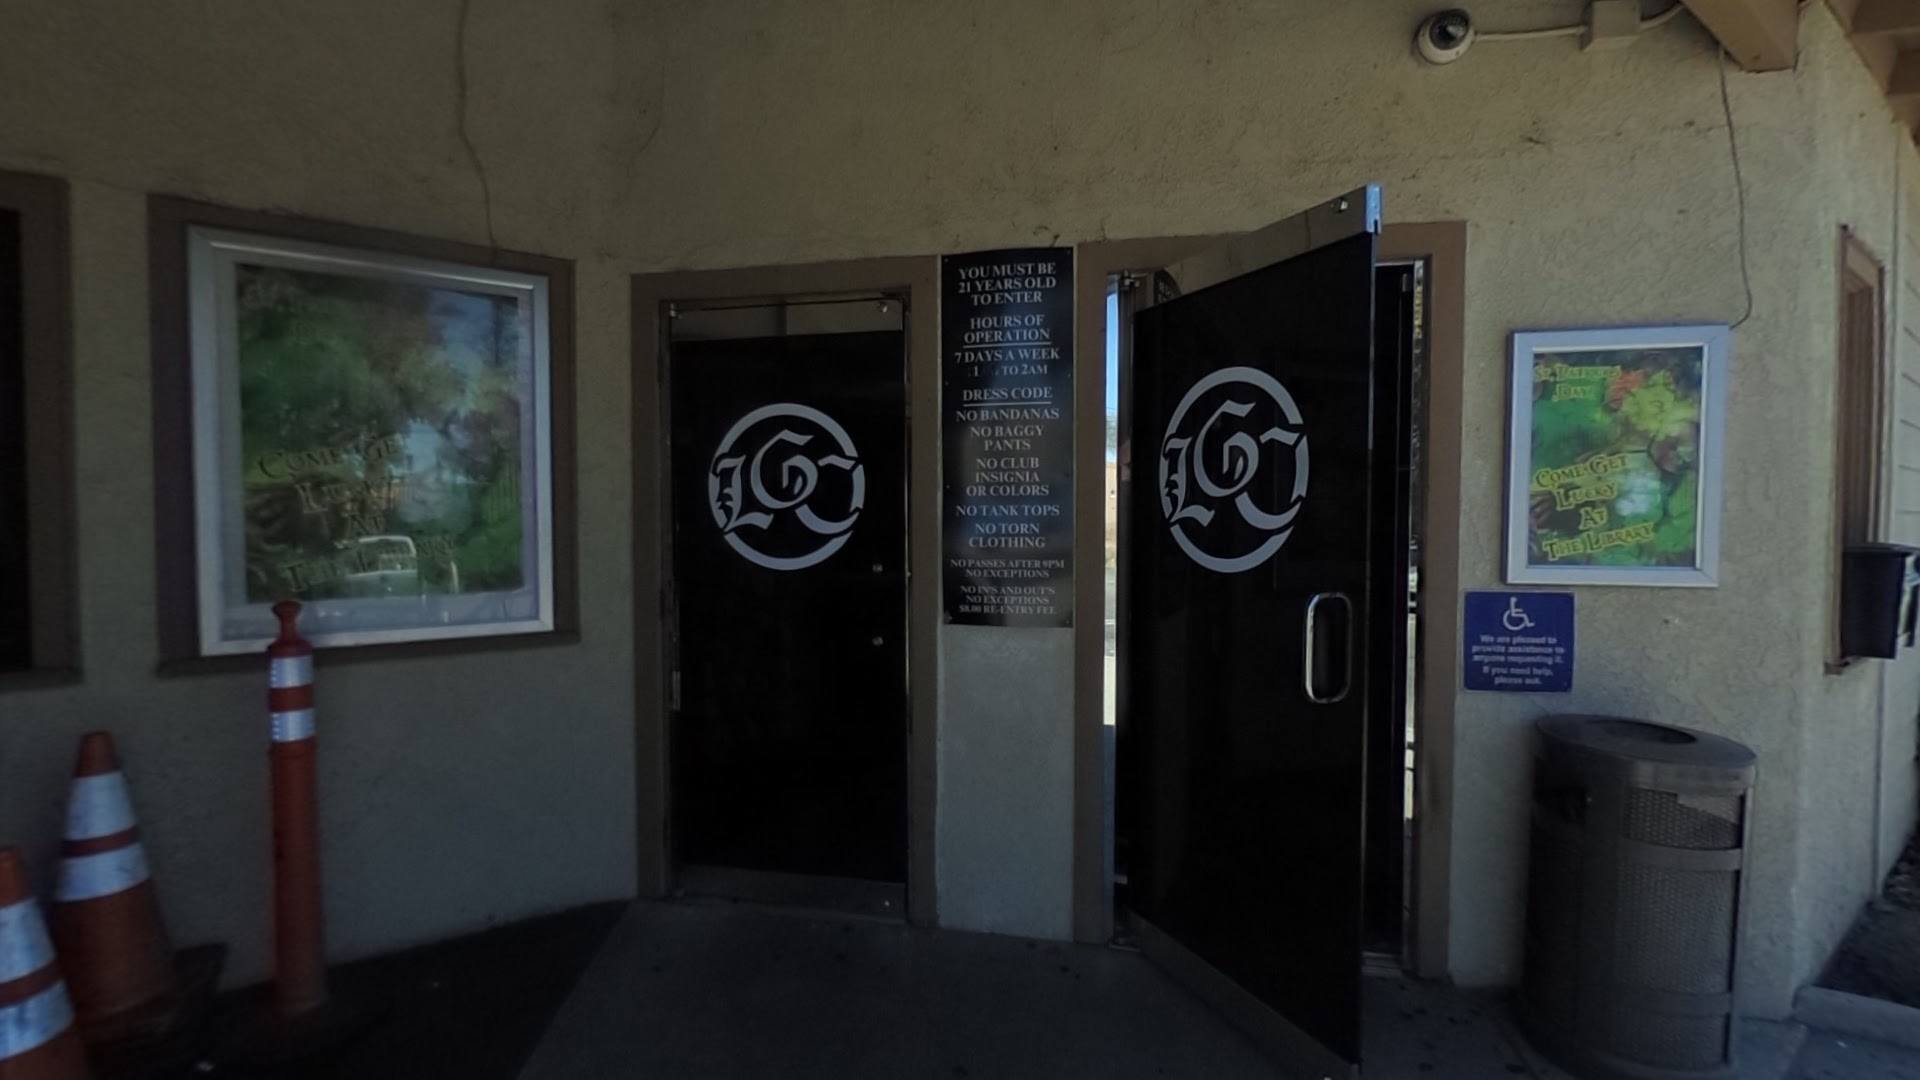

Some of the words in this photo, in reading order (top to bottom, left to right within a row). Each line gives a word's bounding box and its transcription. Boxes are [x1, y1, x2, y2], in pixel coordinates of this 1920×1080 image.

[958, 266, 990, 280] YOU
[992, 263, 1034, 277] MUST
[1037, 262, 1057, 275] BE
[958, 282, 971, 294] 21
[975, 279, 1022, 292] YEARS
[1024, 276, 1057, 289] OLD
[971, 293, 992, 306] TO
[994, 290, 1043, 305] ENTER
[970, 315, 1022, 329] HOURS
[1024, 313, 1045, 327] OF
[964, 328, 1051, 344] OPERATION
[954, 352, 962, 363] 7
[964, 350, 1002, 363] DAYS
[1004, 349, 1016, 361] A
[1018, 347, 1060, 360] WEEK
[1001, 365, 1018, 376] TO
[1021, 363, 1048, 375] 2AM
[963, 388, 1008, 401] DRESS
[1011, 386, 1053, 399] CODE
[956, 410, 977, 422] NO
[980, 407, 1060, 420] BANDANAS
[970, 425, 992, 438] NO
[994, 424, 1044, 437] BAGGY
[984, 439, 1031, 451] PANTS
[976, 458, 998, 470] NO
[1000, 456, 1040, 469] CLUB
[975, 471, 1040, 483] INSIGNIA
[965, 484, 986, 497] OR
[989, 484, 1050, 496] COLORS
[956, 504, 977, 517] NO
[980, 504, 1018, 516] TANK
[1023, 504, 1060, 516] TOPS
[975, 522, 997, 535] NO
[999, 522, 1040, 534] TORN
[968, 536, 1047, 549] CLOTHING
[950, 559, 966, 569] NO
[968, 559, 1006, 569] PASSES
[1007, 559, 1041, 569] AFTER
[965, 568, 981, 578] NO
[983, 568, 1050, 579] EXCEPTIONS
[960, 585, 977, 594] NO
[1000, 585, 1022, 595] AND
[965, 594, 981, 604] NO
[983, 594, 1050, 605] EXCEPTIONS
